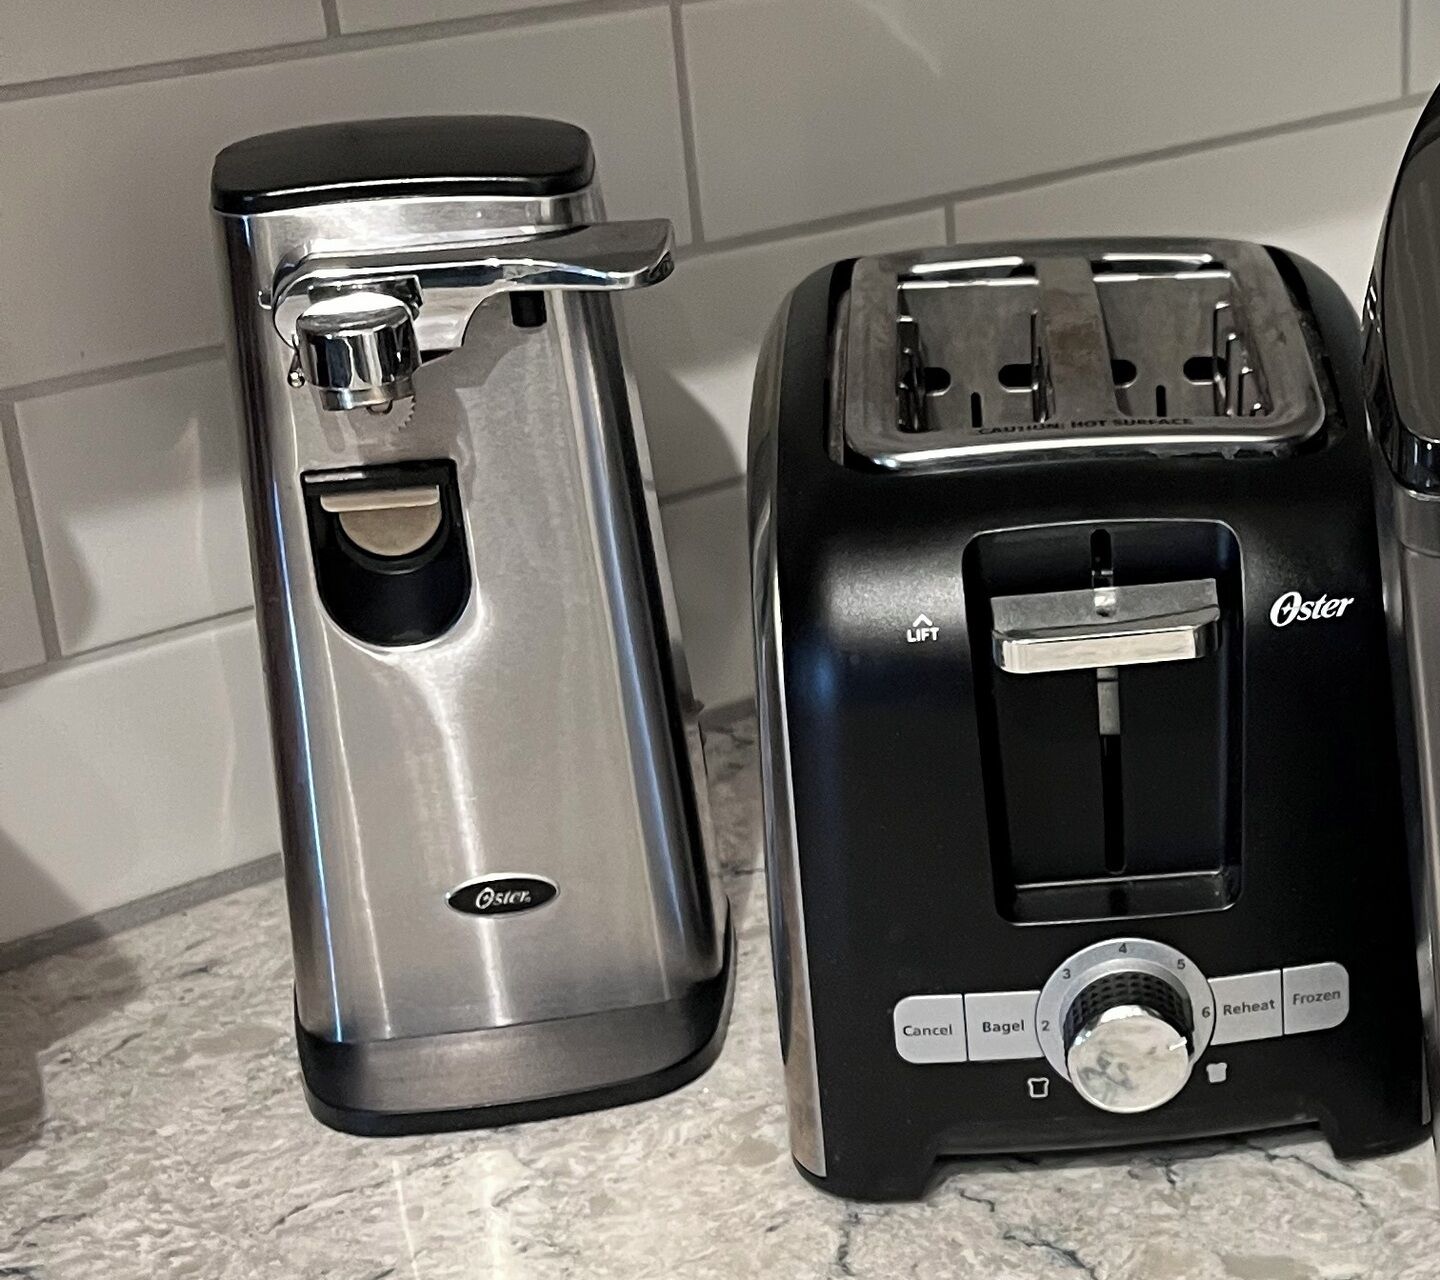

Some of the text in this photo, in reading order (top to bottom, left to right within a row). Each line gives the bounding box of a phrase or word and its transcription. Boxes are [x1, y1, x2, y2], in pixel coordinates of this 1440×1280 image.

[1071, 420, 1106, 428] HOT
[1270, 591, 1355, 627] Oster
[906, 627, 940, 643] LIFT
[475, 886, 532, 910] Oster
[1118, 942, 1128, 954] 4
[1177, 958, 1186, 971] 5
[1062, 968, 1072, 980] 3
[1292, 990, 1342, 1006] Frozen
[1201, 1006, 1211, 1019] 6
[1223, 998, 1276, 1017] Reheat
[902, 1024, 954, 1038] Cancel
[982, 1019, 1026, 1035] Bagel
[1041, 1020, 1051, 1032] 2
